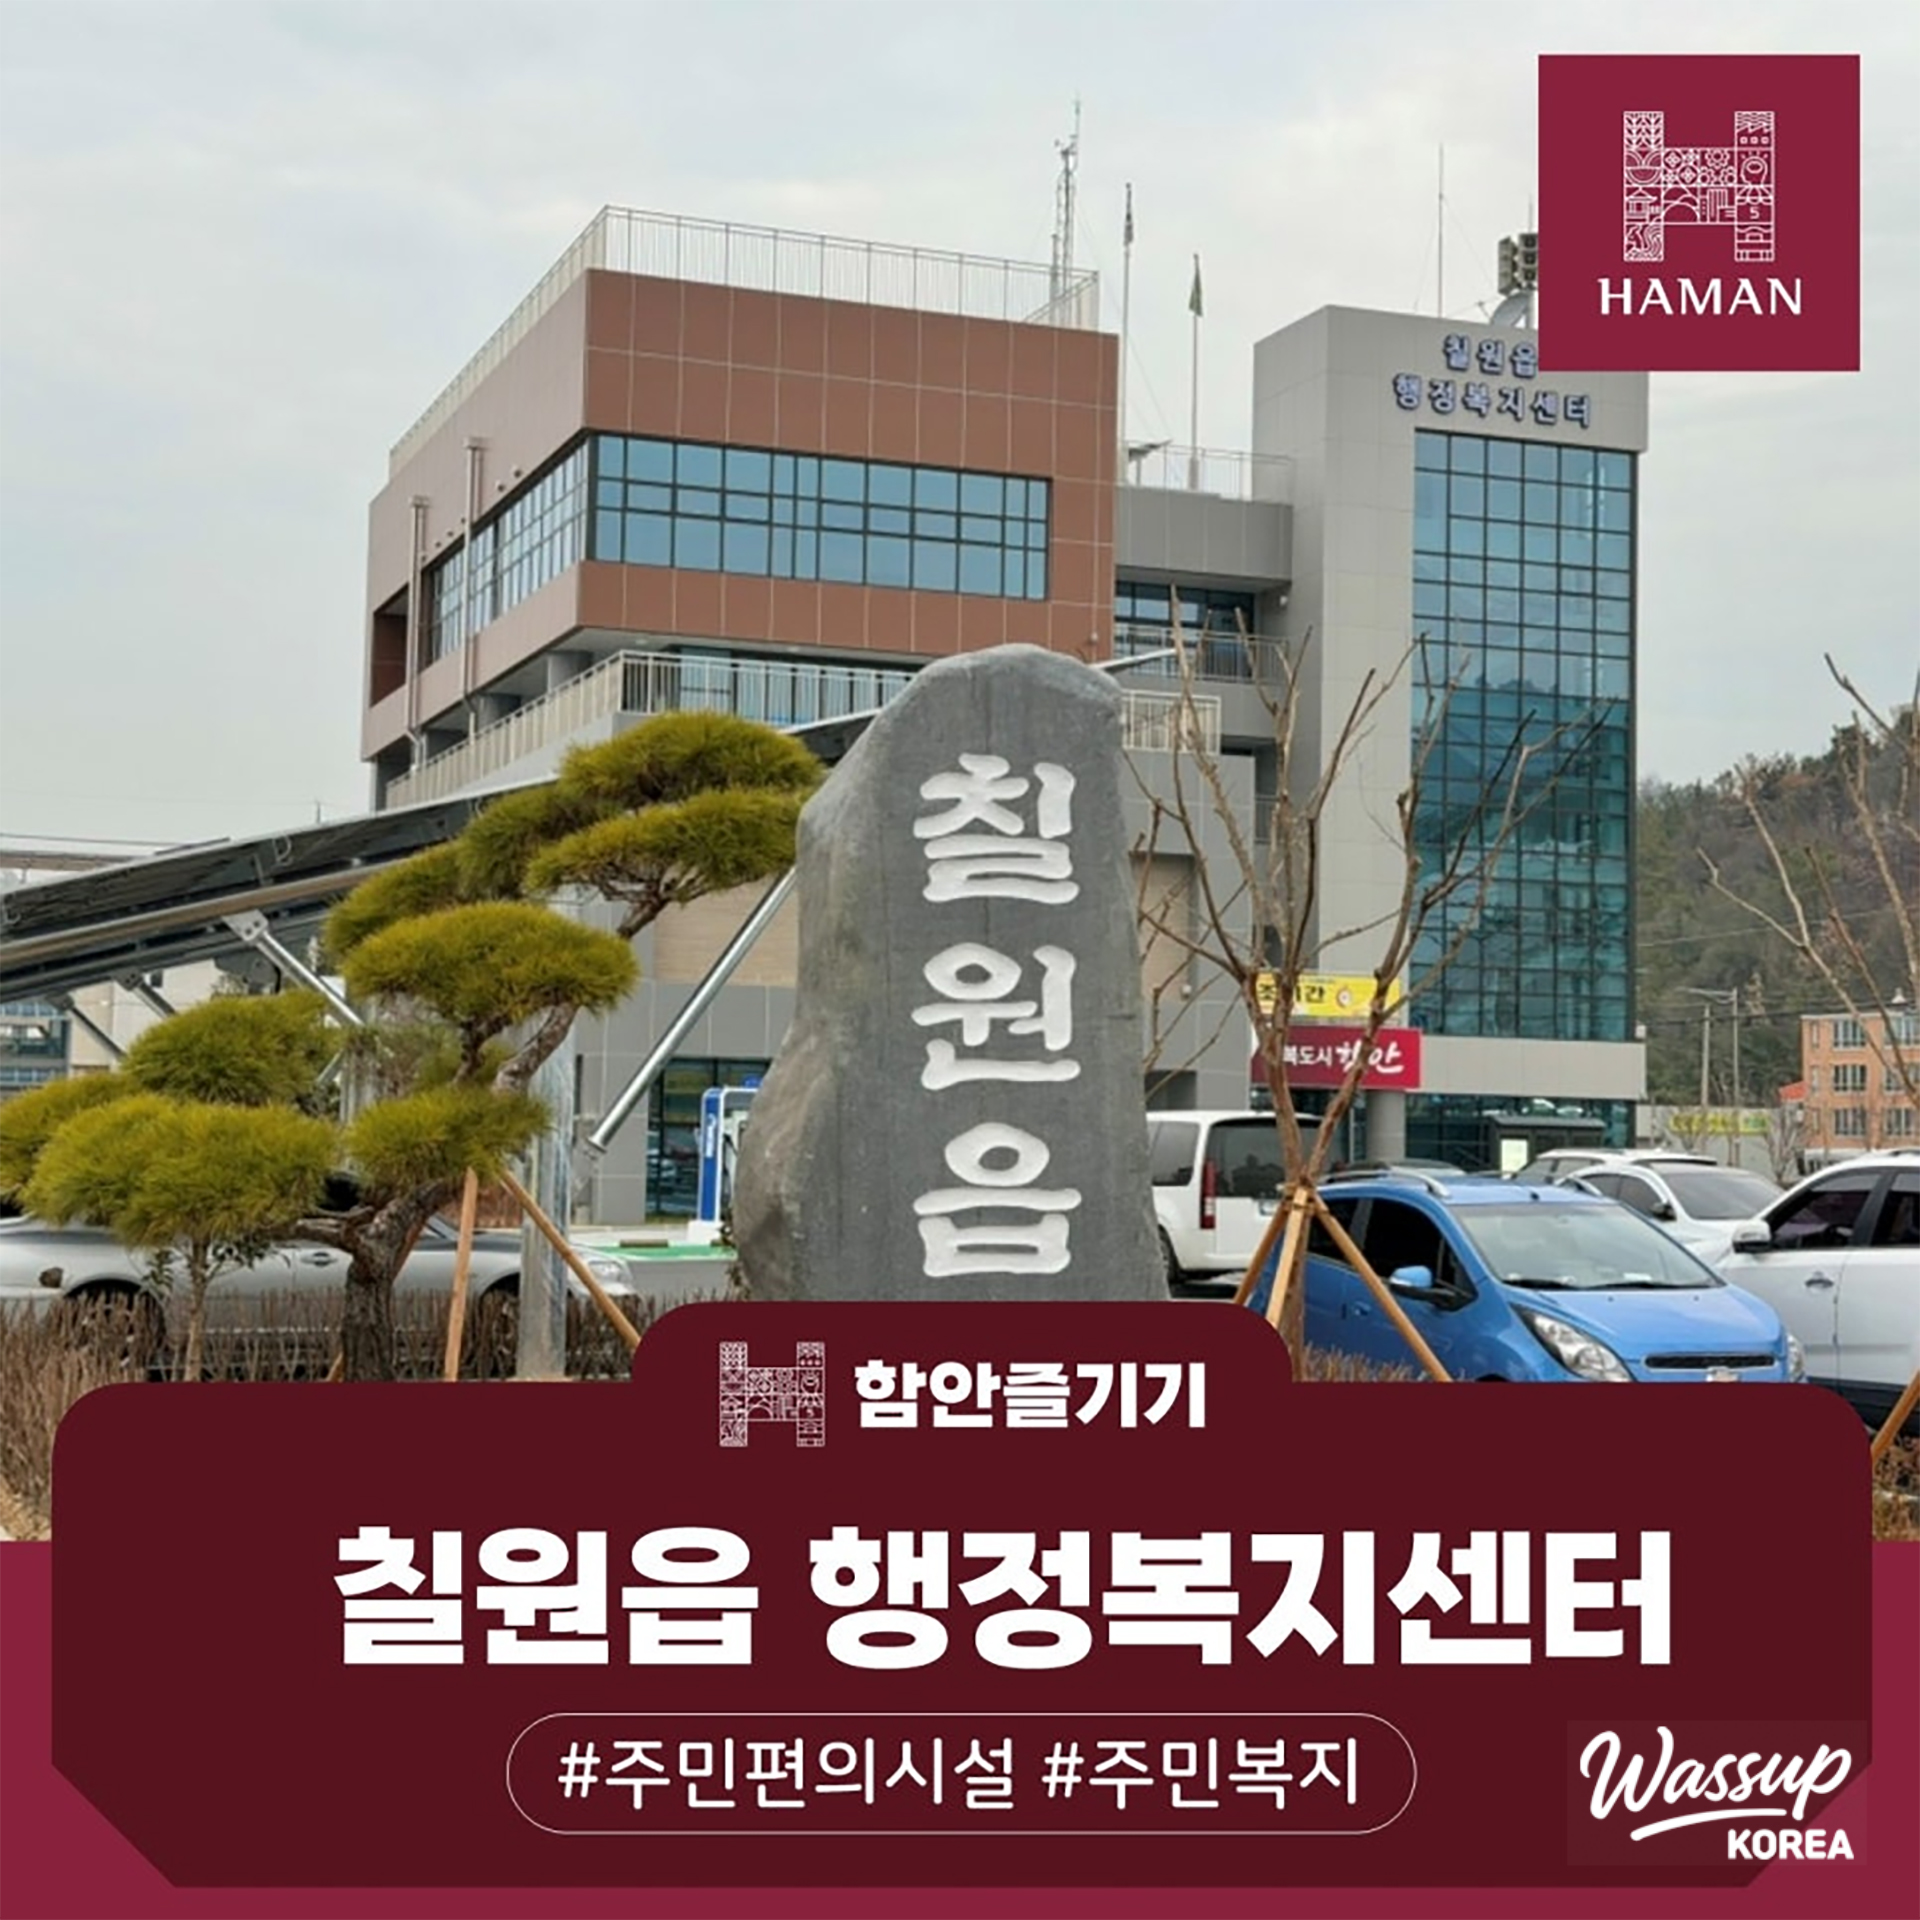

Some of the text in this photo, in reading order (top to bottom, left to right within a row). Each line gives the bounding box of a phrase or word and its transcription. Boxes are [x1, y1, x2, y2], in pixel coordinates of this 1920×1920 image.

[1443, 334, 1538, 379] 칠원읍
[1393, 373, 1591, 429] 행정복지센터
[912, 753, 1082, 1278] 칠원읍
